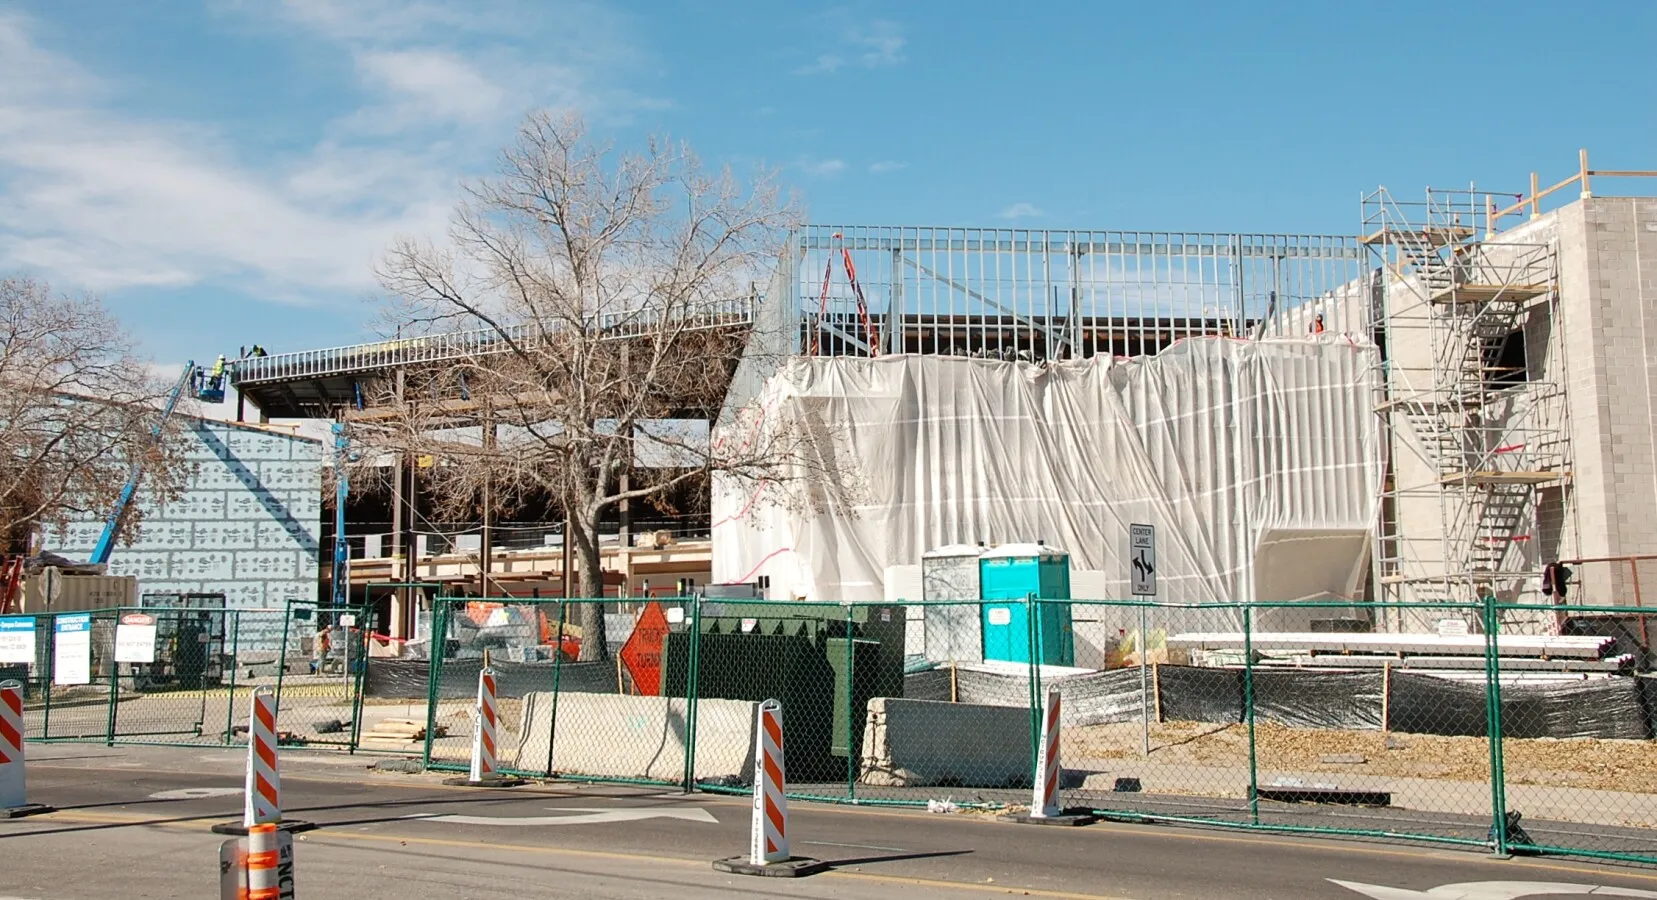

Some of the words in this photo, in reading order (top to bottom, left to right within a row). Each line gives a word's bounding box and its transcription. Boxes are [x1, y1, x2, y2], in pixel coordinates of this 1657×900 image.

[1132, 527, 1152, 536] CENTER
[1135, 537, 1149, 545] LANE
[1137, 584, 1150, 592] ONLY
